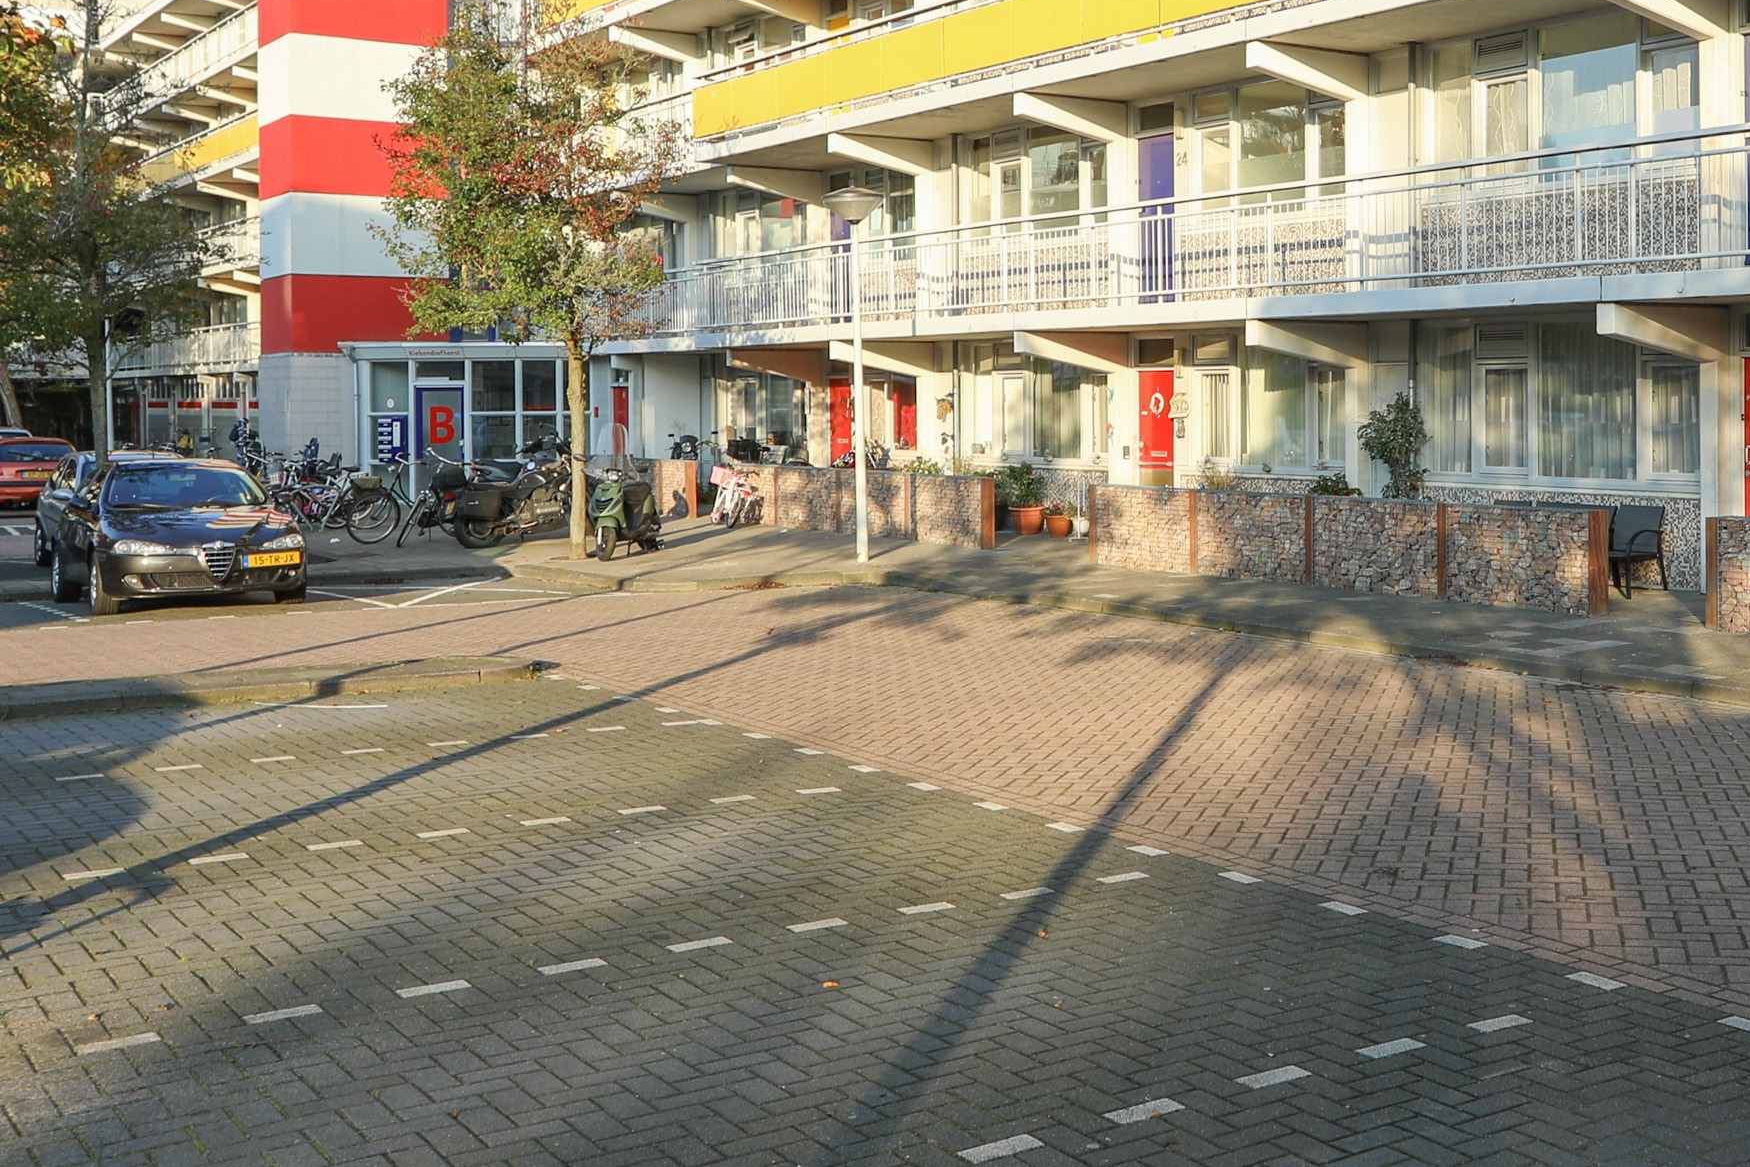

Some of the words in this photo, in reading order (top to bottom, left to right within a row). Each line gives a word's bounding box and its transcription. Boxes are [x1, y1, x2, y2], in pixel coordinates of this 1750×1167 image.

[1176, 151, 1188, 167] 24
[429, 406, 455, 444] B
[254, 553, 295, 566] 15-TR-JX
